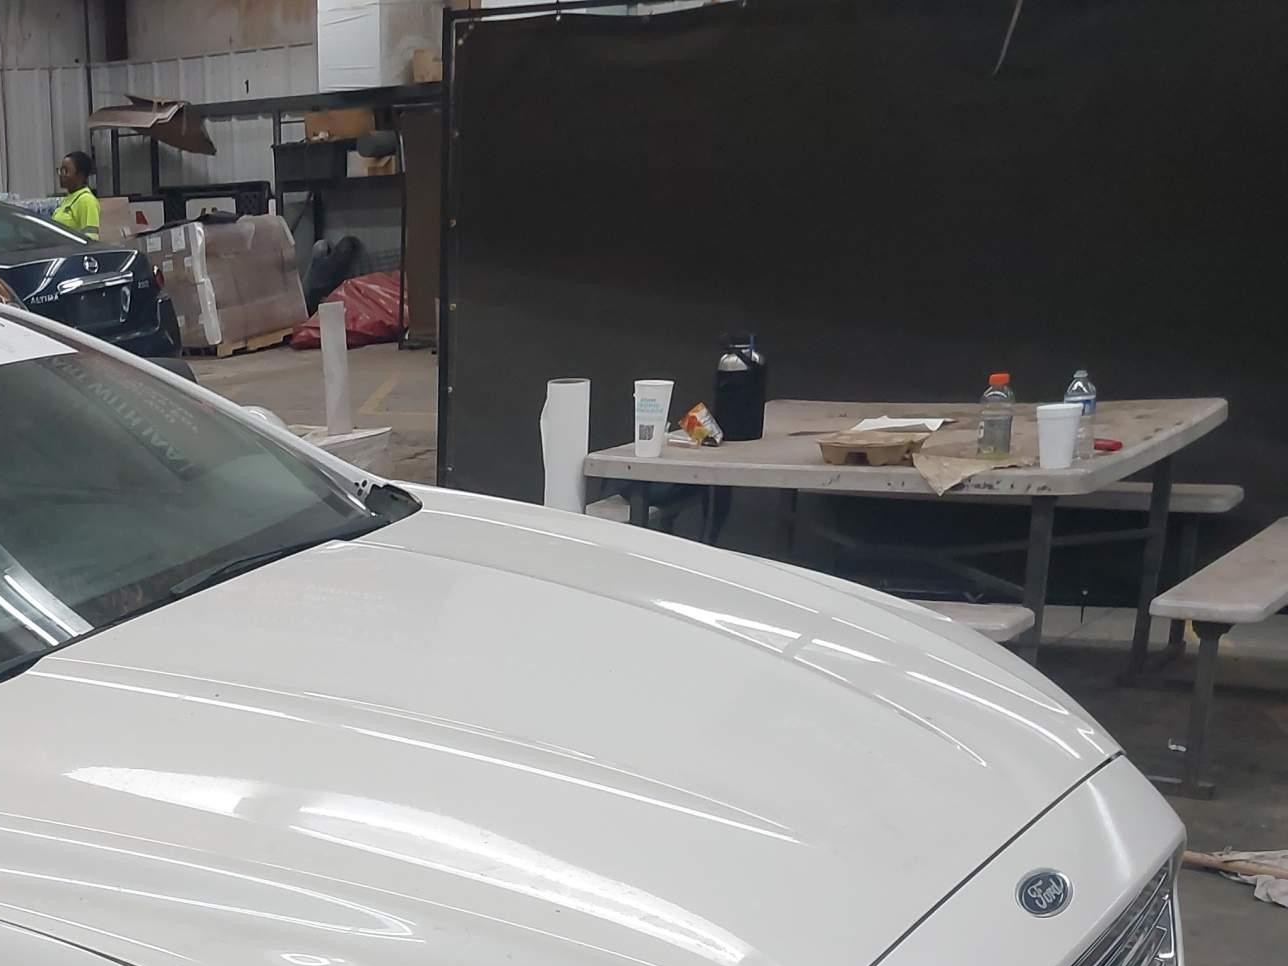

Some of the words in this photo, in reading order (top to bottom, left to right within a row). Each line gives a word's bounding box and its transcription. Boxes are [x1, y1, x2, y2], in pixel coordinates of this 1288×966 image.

[243, 79, 250, 95] 1
[30, 293, 60, 305] ALTIMA
[1027, 877, 1064, 909] Ford
